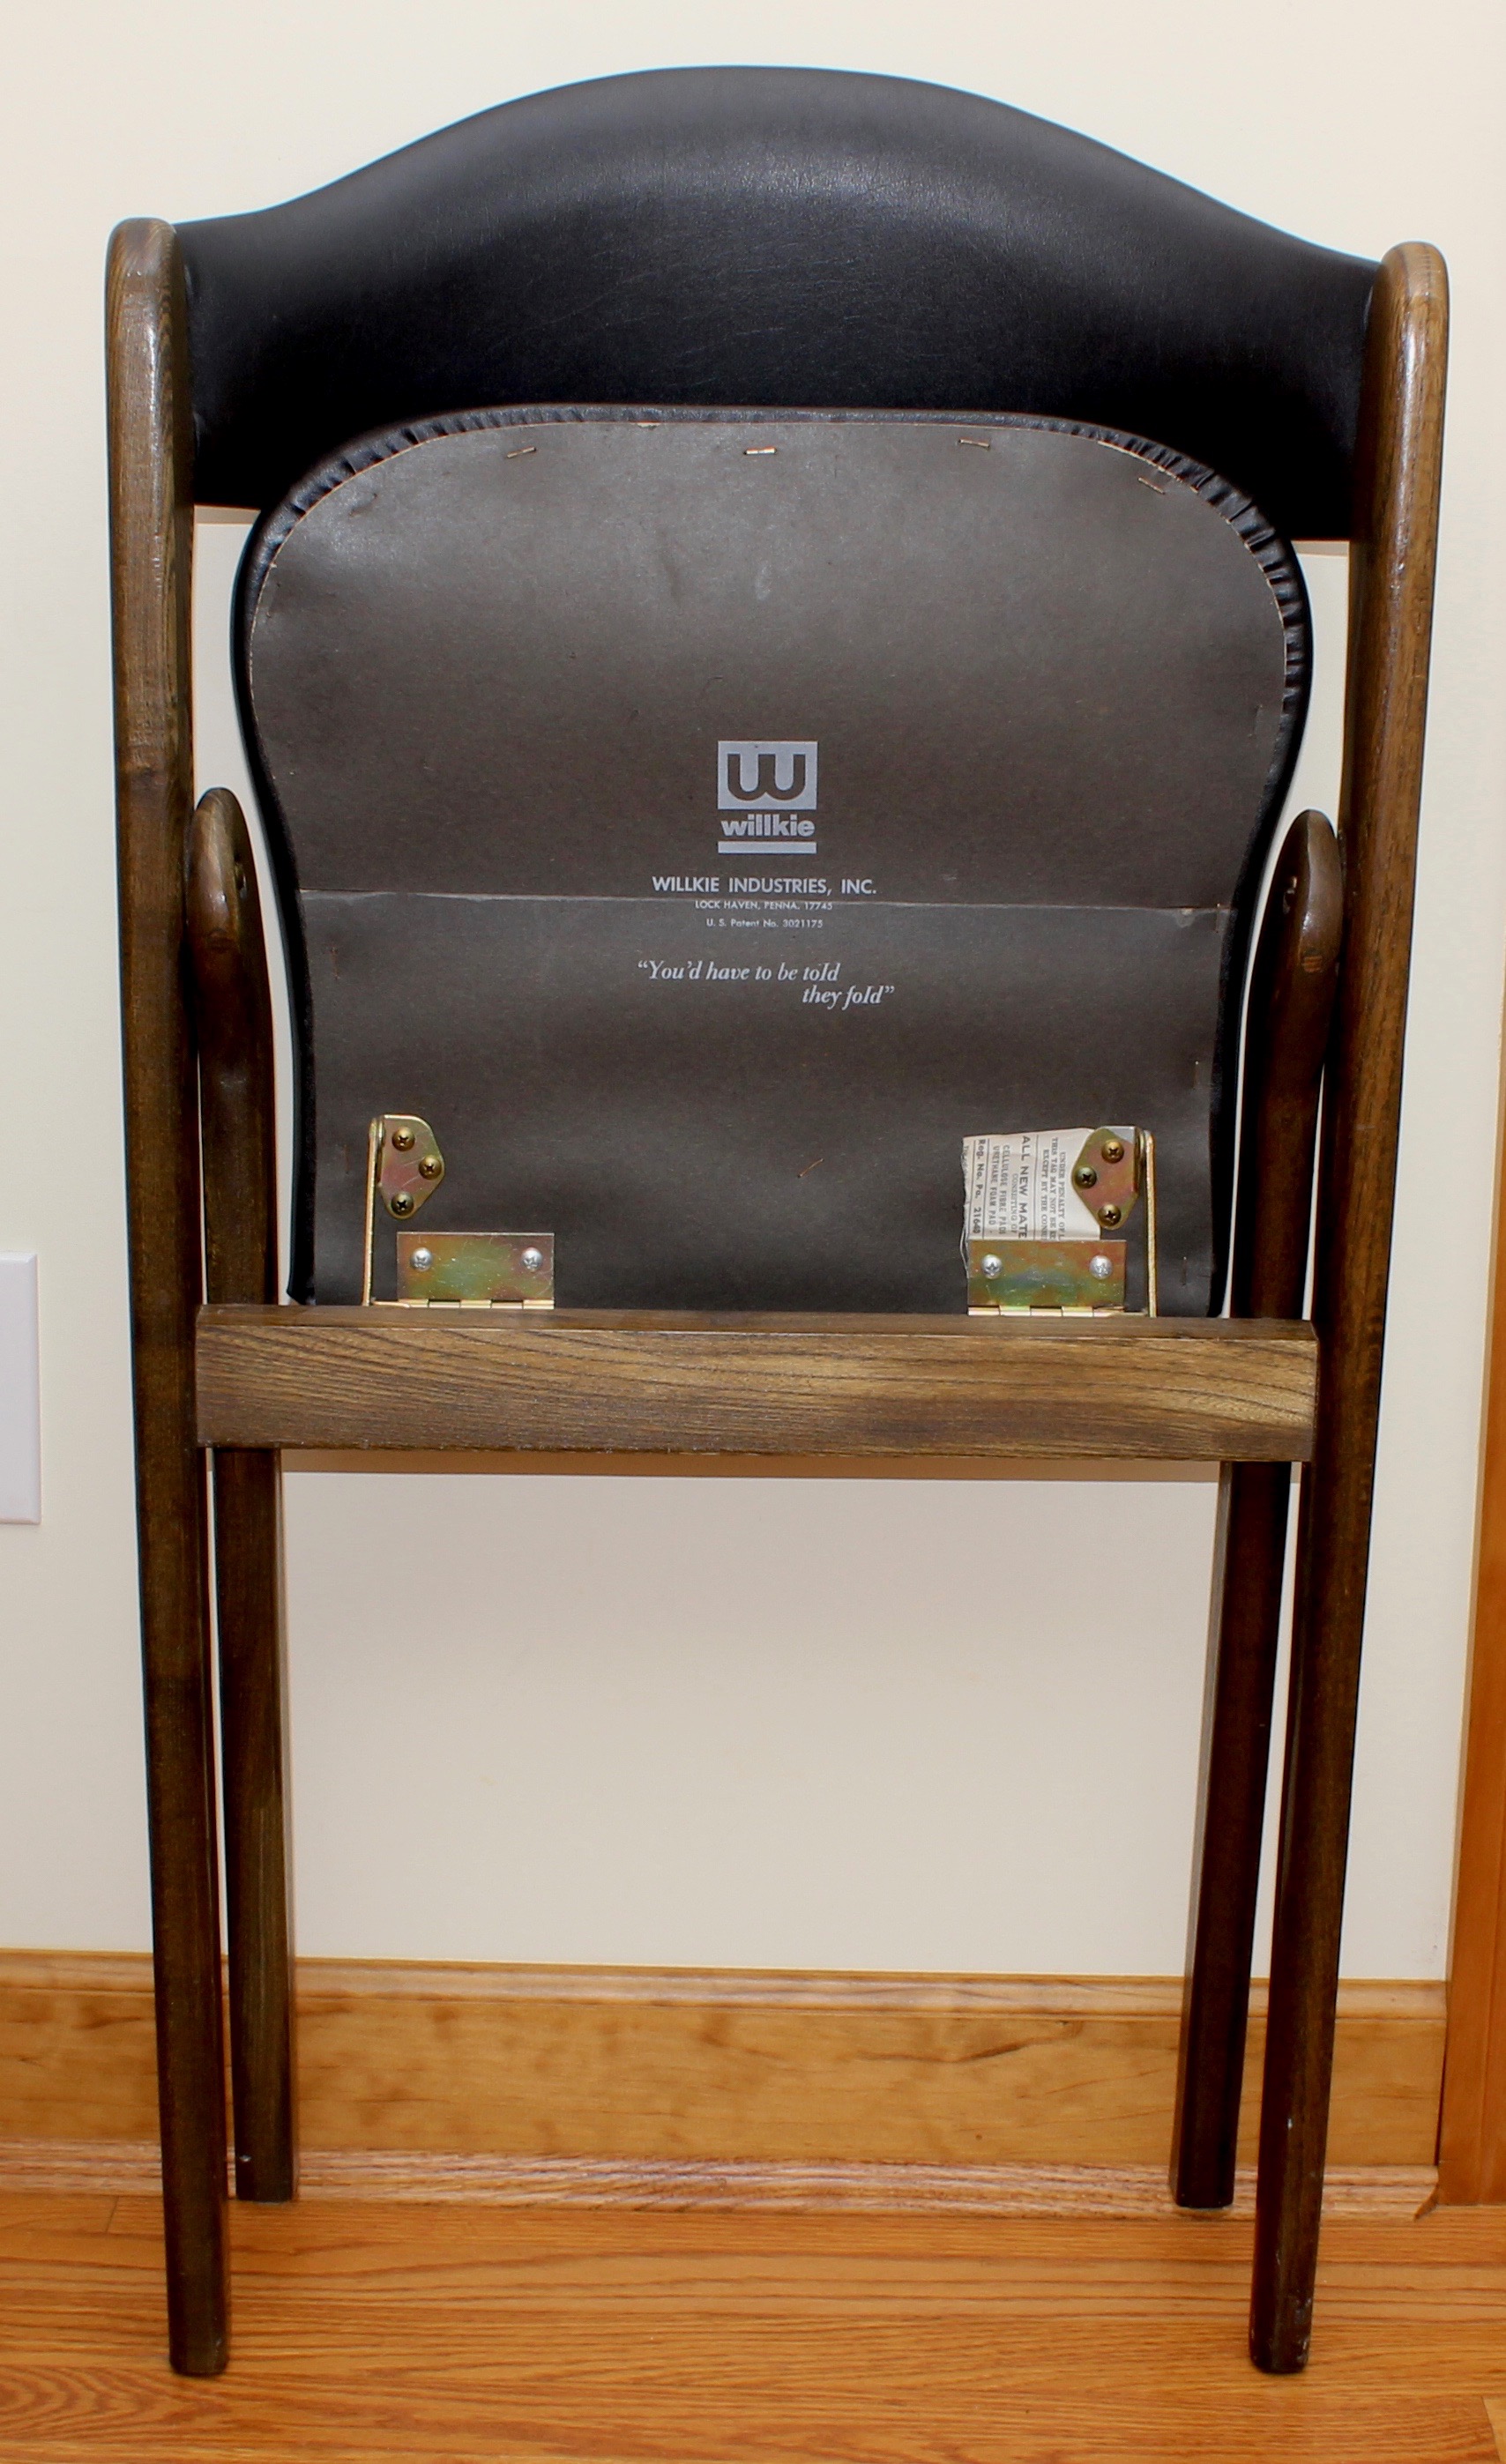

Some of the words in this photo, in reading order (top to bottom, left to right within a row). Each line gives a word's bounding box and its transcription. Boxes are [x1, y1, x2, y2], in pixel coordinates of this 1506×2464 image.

[720, 814, 816, 837] willkie
[652, 876, 719, 892] WILLKIE
[728, 877, 831, 896] INDUSTRIES,
[841, 880, 876, 894] INC.
[695, 900, 720, 909] LOCK
[724, 900, 761, 910] HAVEN,
[764, 901, 800, 910] PENNA.
[804, 901, 833, 910] 17745
[763, 919, 779, 927] No.
[782, 919, 824, 928] 3021175
[705, 962, 750, 980] have
[755, 965, 772, 981] to
[777, 963, 798, 981] be
[802, 963, 841, 982] told
[801, 985, 842, 1010] they
[976, 1139, 986, 1160] Reg.
[1021, 1135, 1031, 1161] ALL
[976, 1163, 985, 1180] No.
[990, 1146, 1000, 1183] URETHANE
[999, 1144, 1010, 1187] CELLULOSE
[1018, 1165, 1030, 1196] NEW
[1040, 1181, 1047, 1192] BY
[974, 1184, 983, 1199] Pa.
[998, 1190, 1007, 1212] FIBRE
[1018, 1202, 1027, 1239] MATE
[1049, 1217, 1056, 1228] BE
